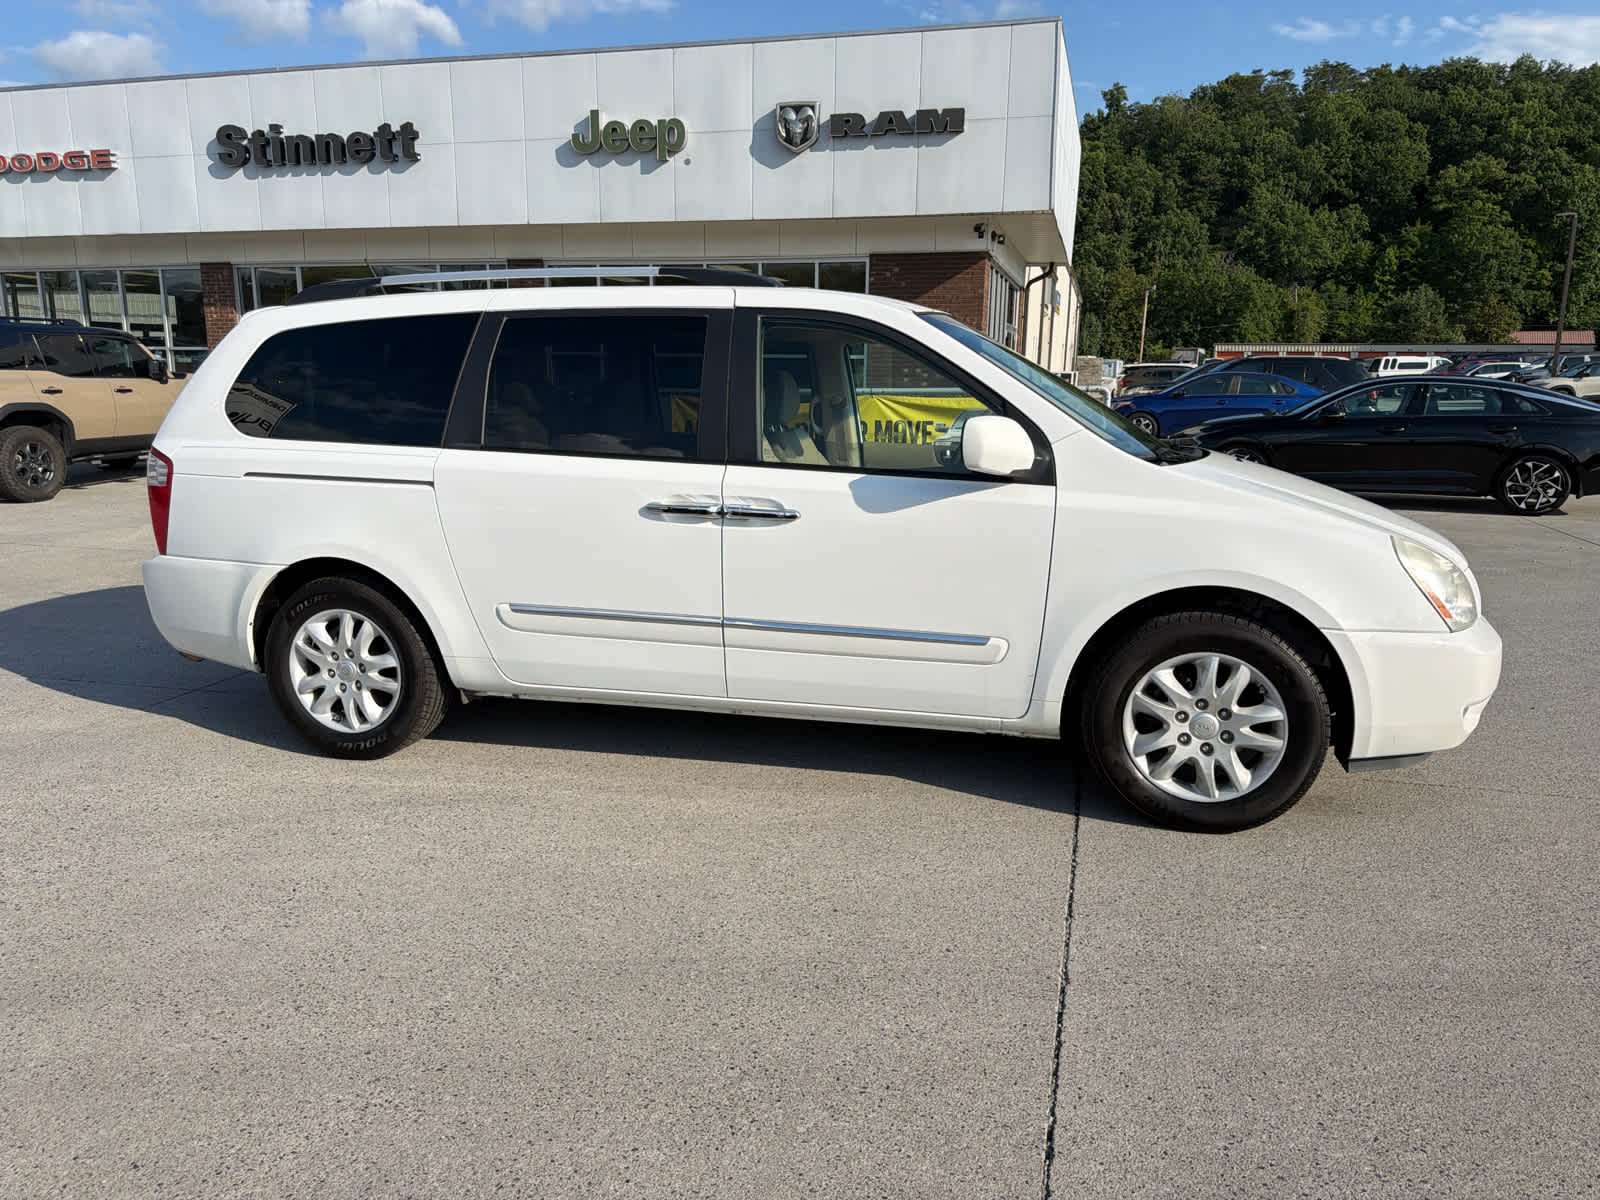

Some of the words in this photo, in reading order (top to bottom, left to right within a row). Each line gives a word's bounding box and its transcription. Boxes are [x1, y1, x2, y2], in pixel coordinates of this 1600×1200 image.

[570, 109, 687, 161] Jeep
[829, 107, 966, 137] RAM
[215, 121, 421, 168] Stinnett
[874, 420, 935, 445] MOVE
